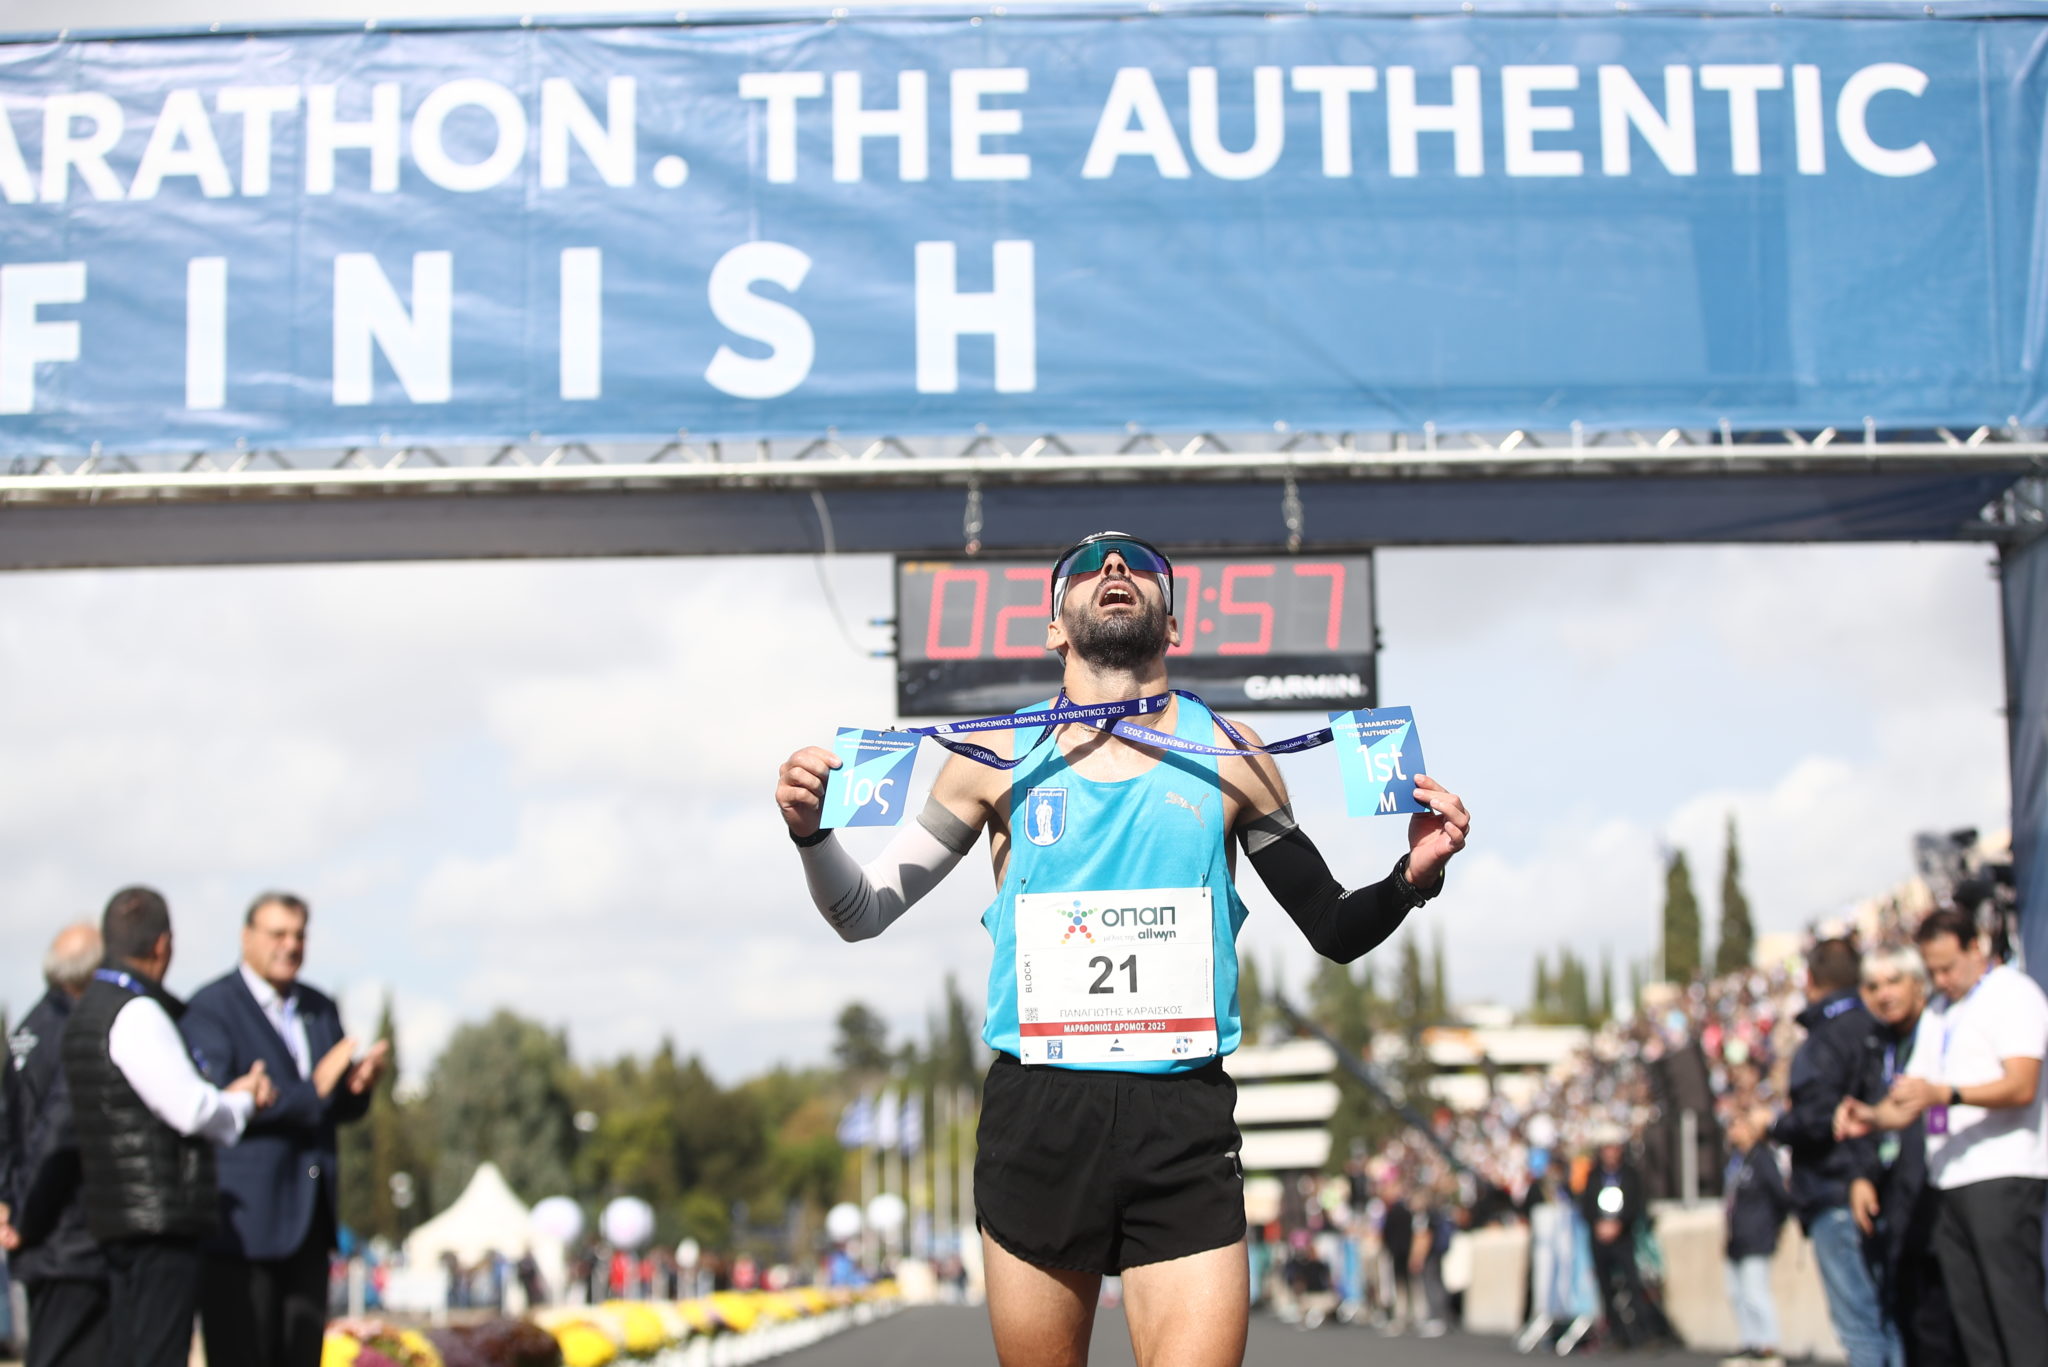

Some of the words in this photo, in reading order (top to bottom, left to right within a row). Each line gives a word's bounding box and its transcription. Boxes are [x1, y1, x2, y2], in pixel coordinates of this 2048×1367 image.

[739, 67, 1031, 184] THE
[1081, 62, 1938, 180] AUTHENTIC
[0, 239, 1036, 416] FINISH
[1244, 673, 1362, 701] GARMIN
[958, 718, 1013, 731] ΜΑΡΑΘΩΝΙΟΣ
[1058, 707, 1107, 721] ΑΥΘΕΝΤΙΚΟΣ
[1108, 705, 1126, 715] 2025
[1123, 725, 1143, 738] 2025
[1364, 718, 1406, 728] MARATHON
[1356, 743, 1407, 783] 1st
[842, 768, 895, 815] 1ος
[1379, 791, 1397, 813] M
[1137, 928, 1177, 942] allwyn
[1024, 959, 1033, 993] BLOCK
[1088, 954, 1138, 995] 21
[1064, 1023, 1113, 1033] ΜΑΡΑΘΩΝΙΟΣ
[1114, 1022, 1146, 1032] ΔΡΟΜΟΣ
[1147, 1021, 1166, 1031] 2025
